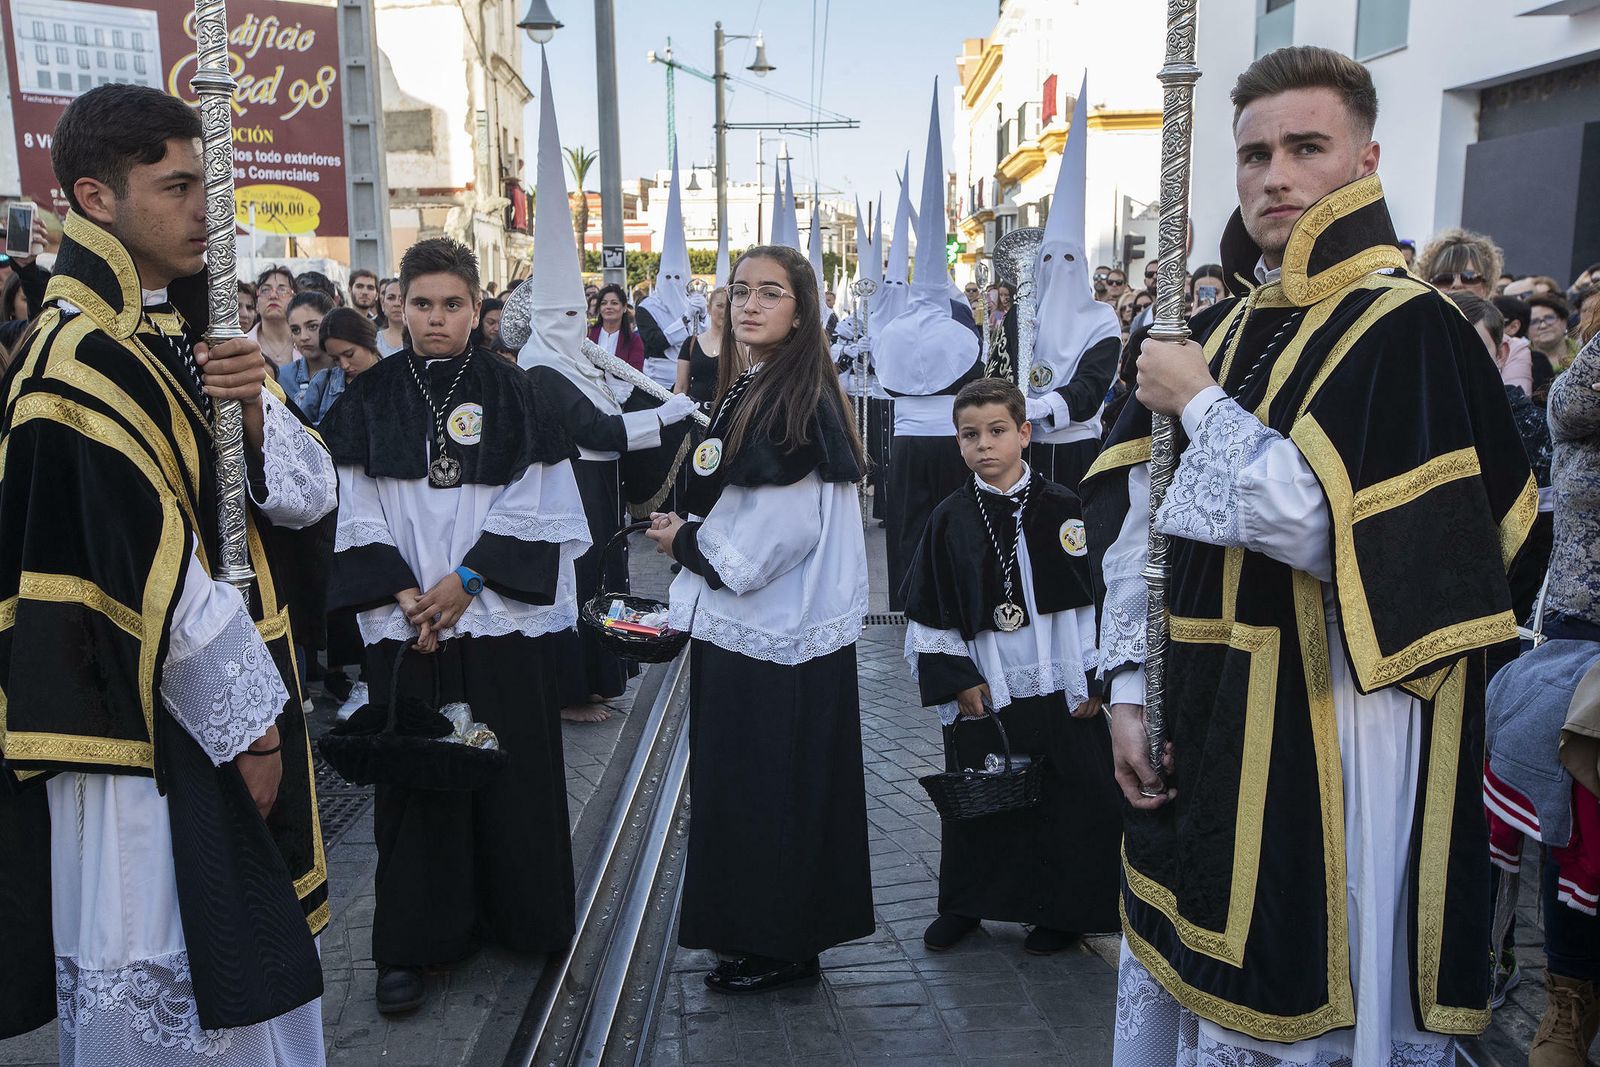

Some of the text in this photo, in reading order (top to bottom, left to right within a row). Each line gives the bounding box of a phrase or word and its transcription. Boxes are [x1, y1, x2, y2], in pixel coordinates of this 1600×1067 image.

[279, 65, 337, 120] 98
[23, 132, 34, 148] 8
[255, 149, 282, 164] todo
[284, 152, 341, 167] exteriores
[248, 165, 320, 182] Comerciales
